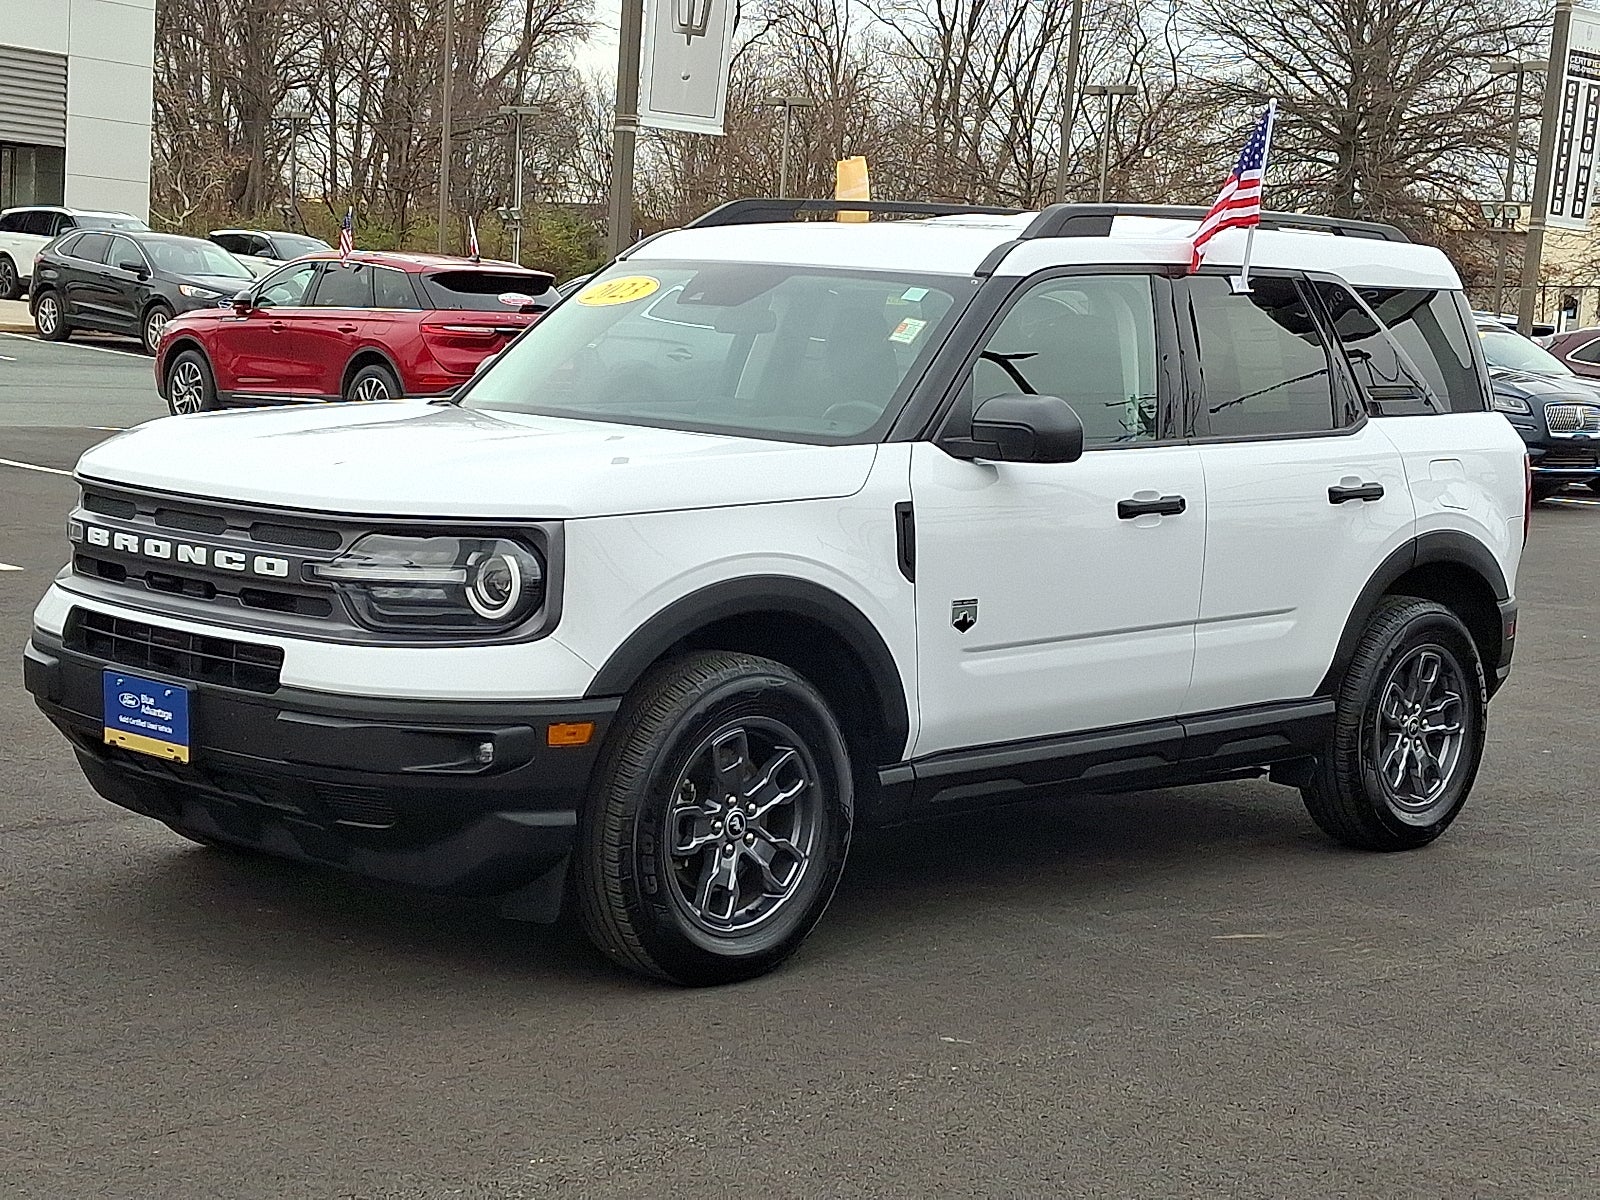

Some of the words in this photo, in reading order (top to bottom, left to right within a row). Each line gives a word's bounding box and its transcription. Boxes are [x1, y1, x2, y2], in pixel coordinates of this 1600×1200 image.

[1552, 83, 1576, 214] CERTIFIED
[87, 526, 289, 578] BRONCO
[141, 693, 155, 705] Blue
[141, 705, 173, 720] Advantage
